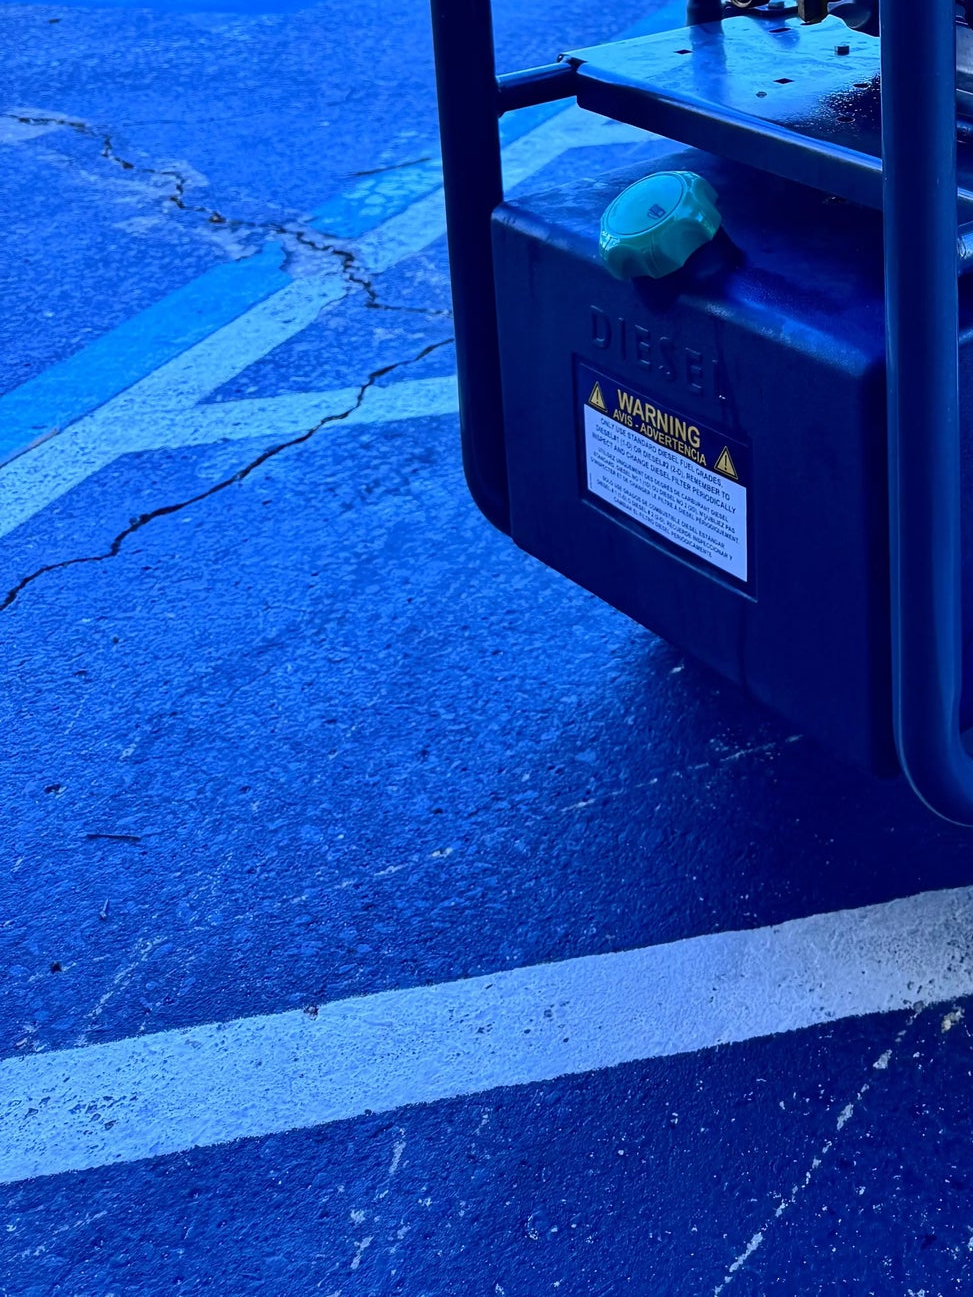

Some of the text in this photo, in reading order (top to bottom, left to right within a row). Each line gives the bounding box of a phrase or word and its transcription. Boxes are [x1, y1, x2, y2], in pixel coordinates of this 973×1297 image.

[590, 304, 726, 402] DIESEL
[613, 409, 633, 427] AVIS
[640, 422, 707, 467] ADVERTENCIA
[617, 388, 701, 449] WARNING
[615, 424, 626, 438] USE
[627, 430, 657, 454] STANDARD
[657, 446, 678, 465] DIESEL
[679, 458, 694, 474] FUEL
[625, 449, 649, 469] CHANGE
[649, 462, 671, 481] DIESEL
[671, 473, 691, 492] FILTER
[692, 484, 736, 516] PERIODICALLY
[685, 470, 720, 498] REMEMBER
